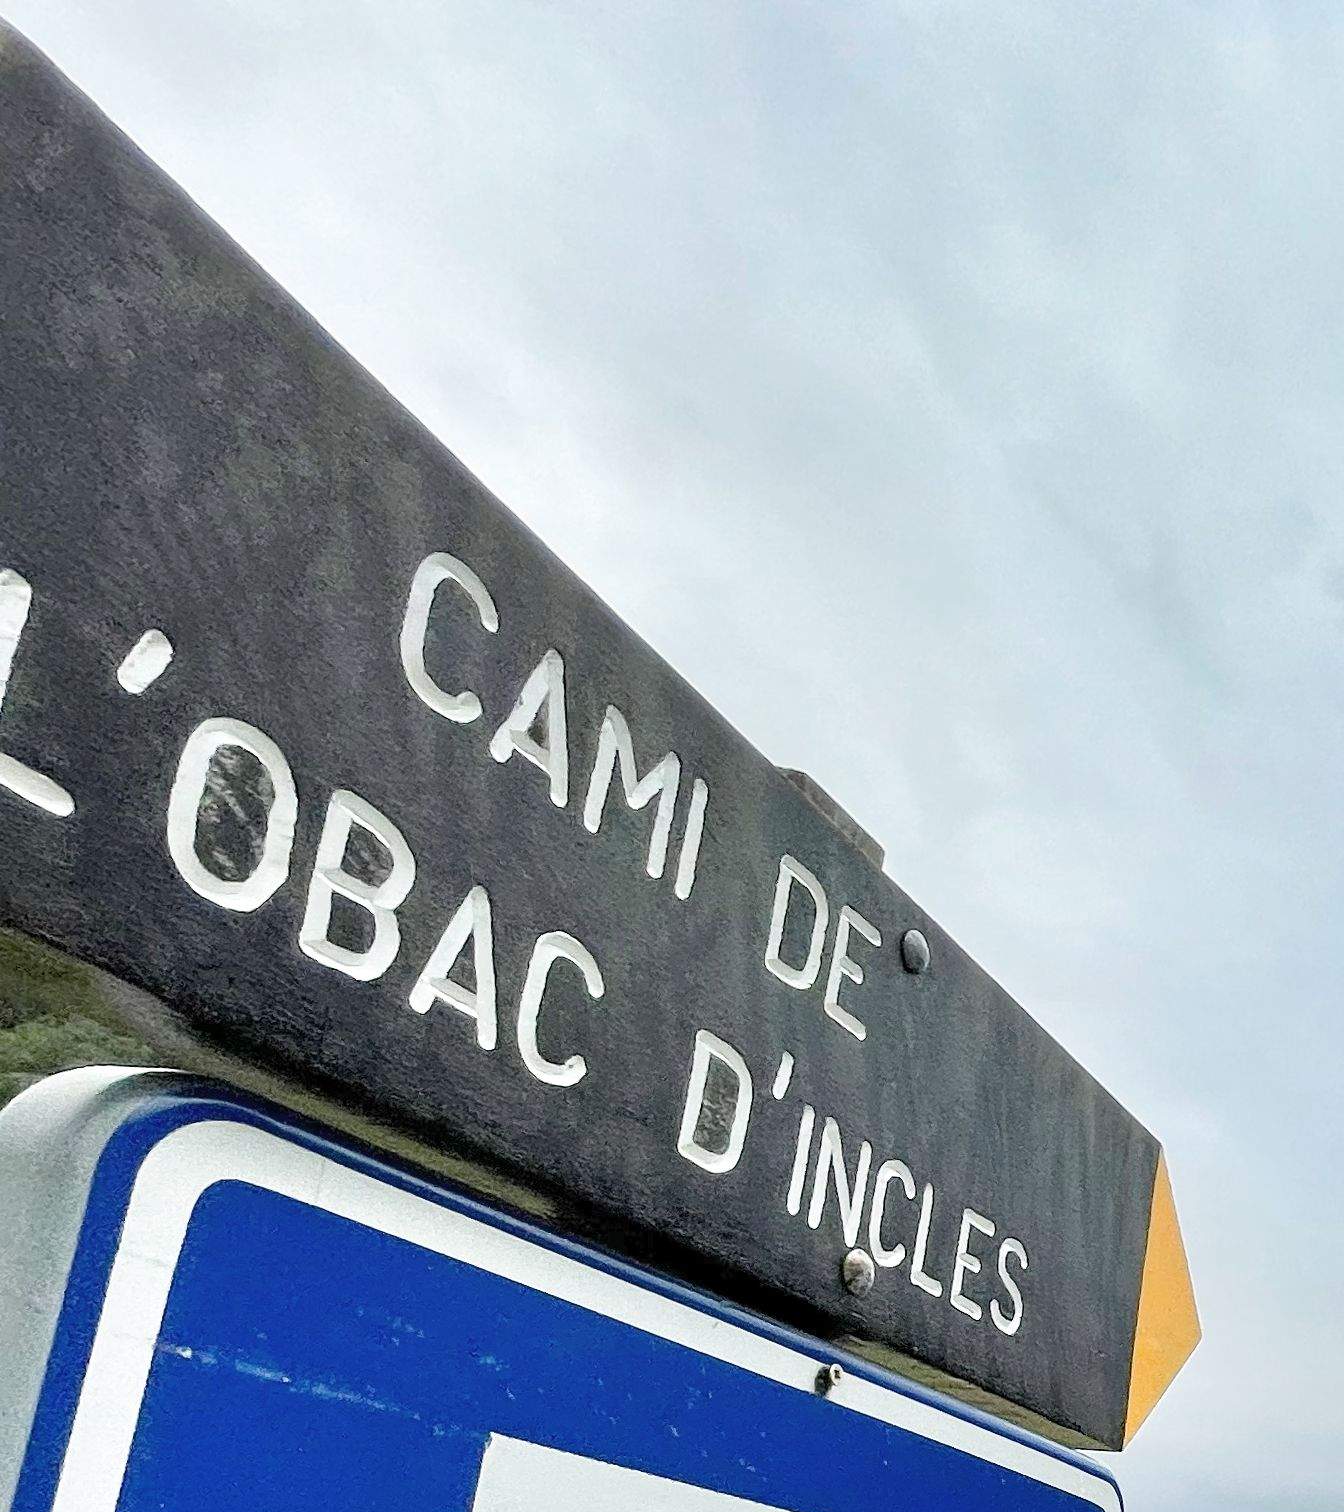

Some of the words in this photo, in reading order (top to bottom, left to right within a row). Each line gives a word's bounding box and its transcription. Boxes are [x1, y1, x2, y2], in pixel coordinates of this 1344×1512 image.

[400, 551, 708, 900] CAMI
[764, 854, 882, 1041] DE
[677, 1029, 1029, 1337] D'INCLES
